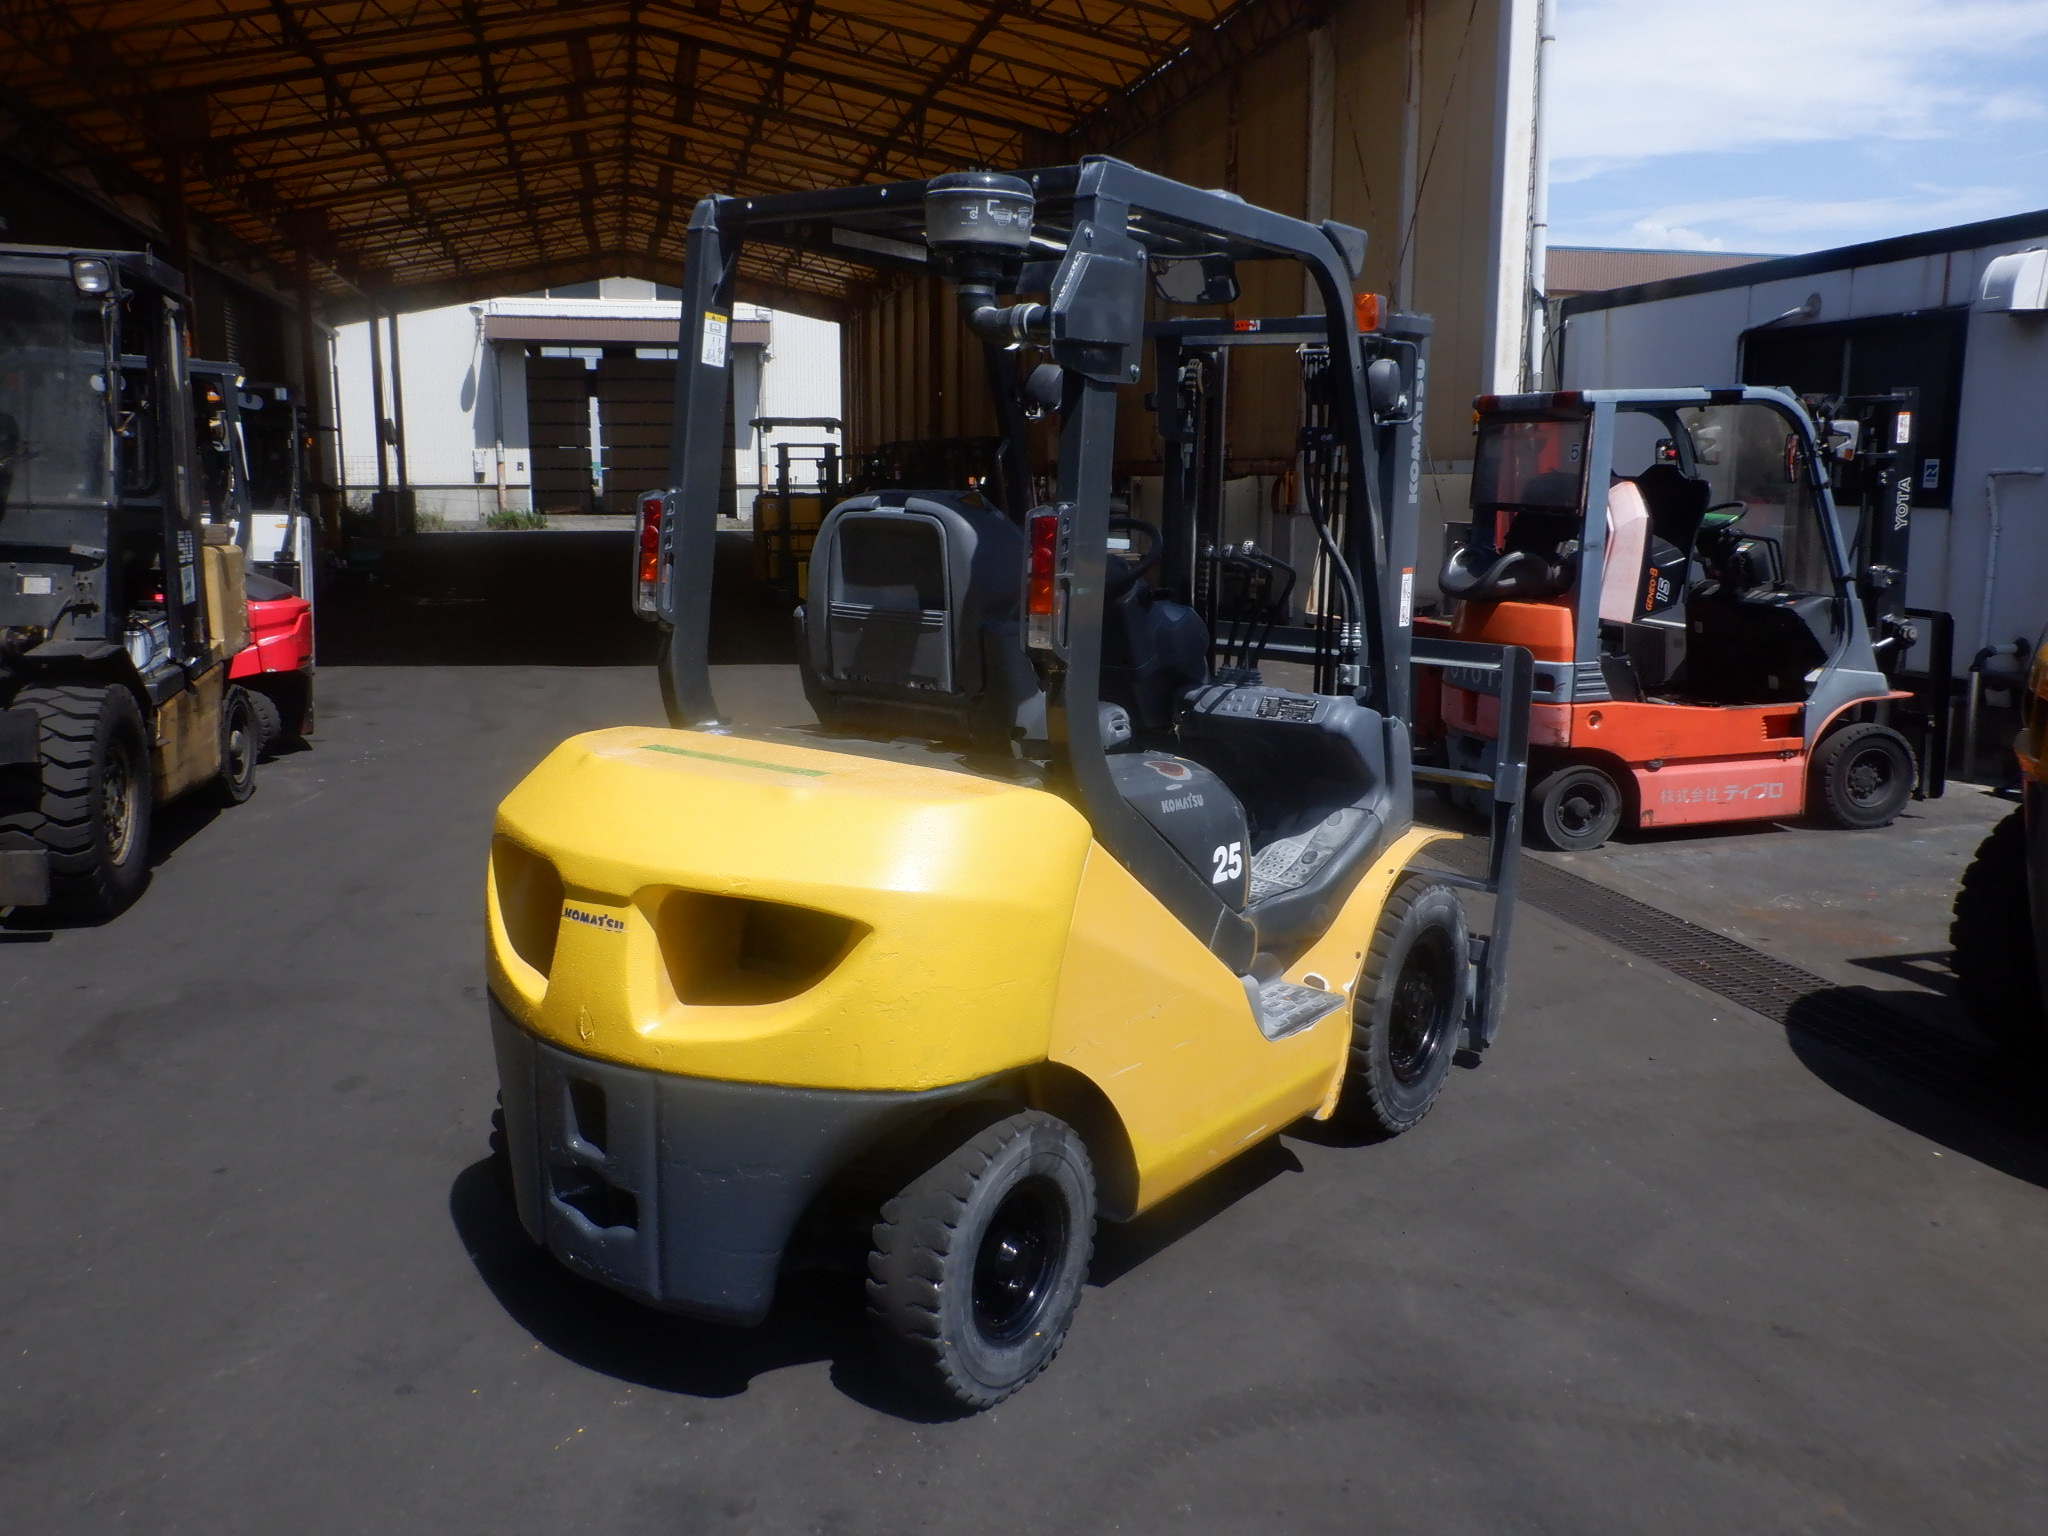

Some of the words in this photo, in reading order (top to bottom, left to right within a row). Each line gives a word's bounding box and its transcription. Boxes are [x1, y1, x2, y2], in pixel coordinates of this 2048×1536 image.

[1408, 358, 1426, 504] KOMATSU
[1571, 443, 1580, 460] 5
[1894, 476, 1912, 531] YOTA
[1655, 577, 1670, 602] 15
[1161, 793, 1204, 813] KOMATSU
[1212, 841, 1242, 885] 25
[564, 907, 625, 930] KOMATSU
